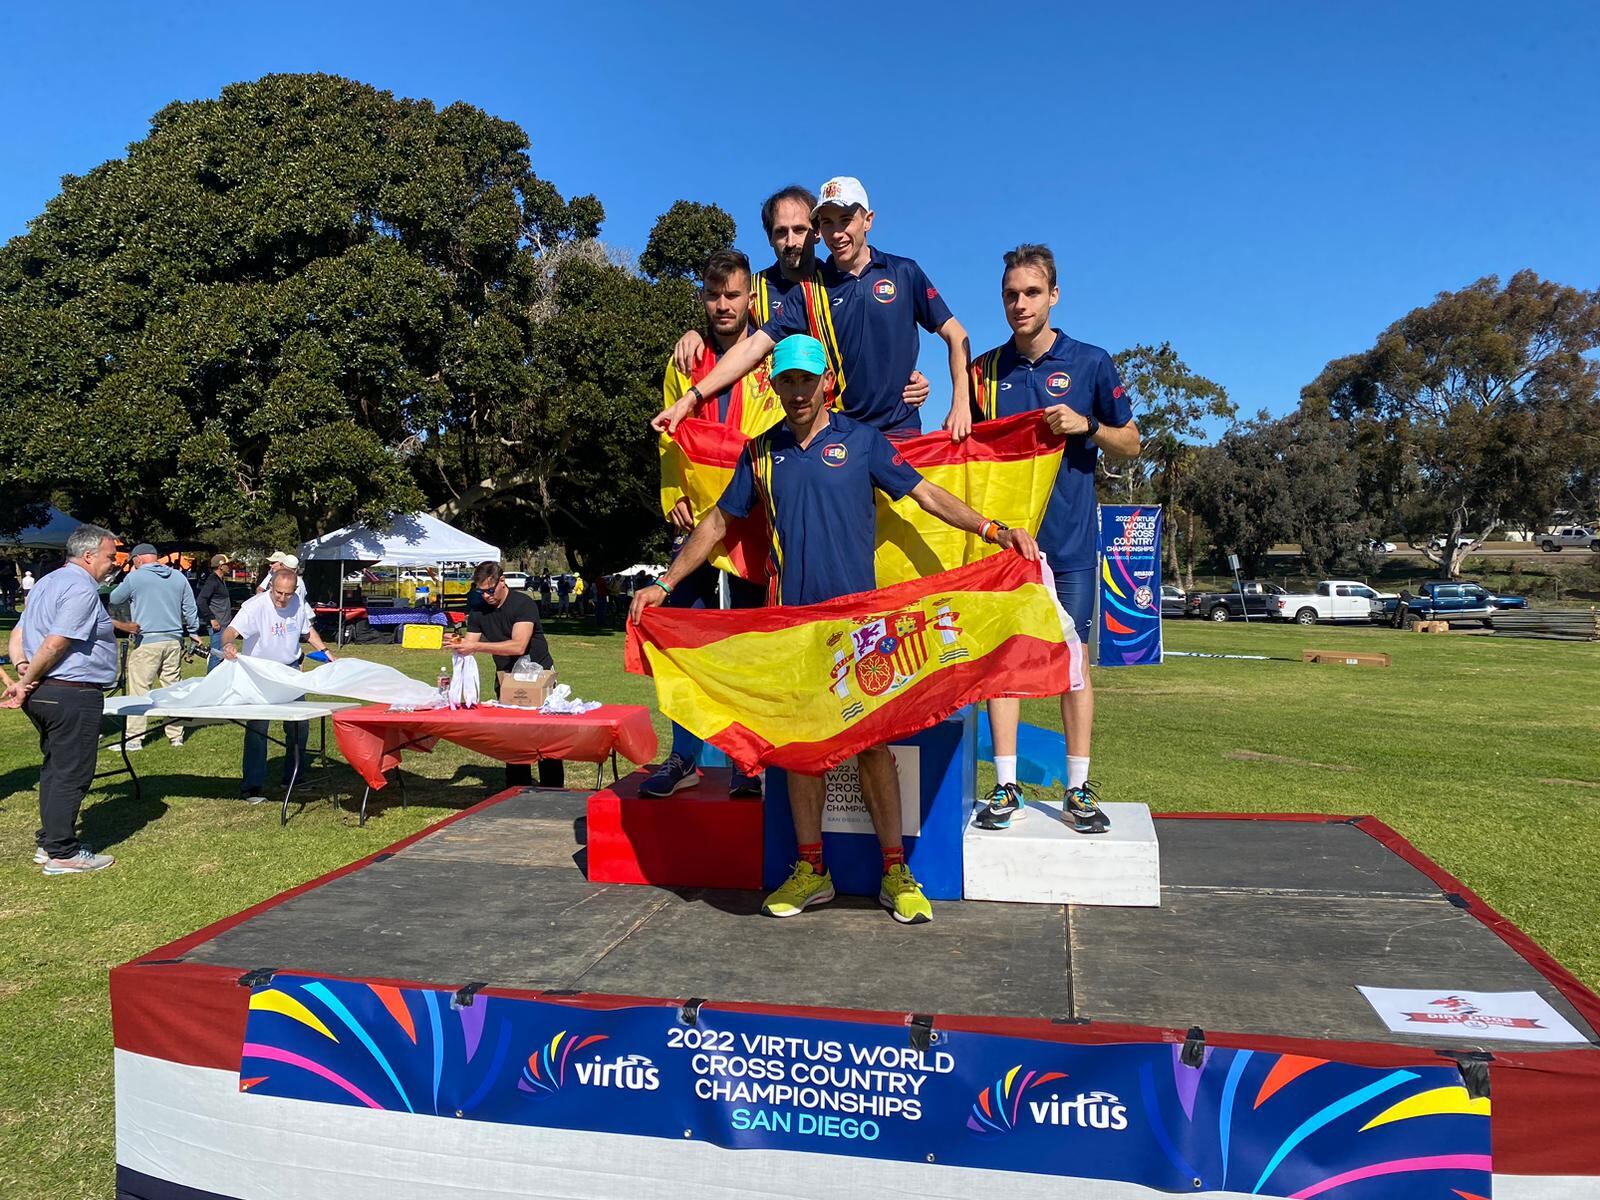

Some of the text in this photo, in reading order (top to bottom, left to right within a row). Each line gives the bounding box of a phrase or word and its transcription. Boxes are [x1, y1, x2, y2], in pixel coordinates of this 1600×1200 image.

[1113, 537, 1154, 545] COUNTRY
[826, 772, 858, 782] WOR
[826, 783, 861, 793] CROS
[826, 793, 864, 803] COUN
[826, 804, 867, 813] CHAMPIO
[667, 1027, 955, 1074] 2022 VIRTUS WORLD
[574, 1054, 660, 1090] virtus
[691, 1053, 927, 1096] CROSS COUNTRY
[694, 1078, 922, 1121] CHAMPIONSHIPS
[1029, 1091, 1128, 1130] virtus
[731, 1108, 880, 1141] SAN DIEGO
